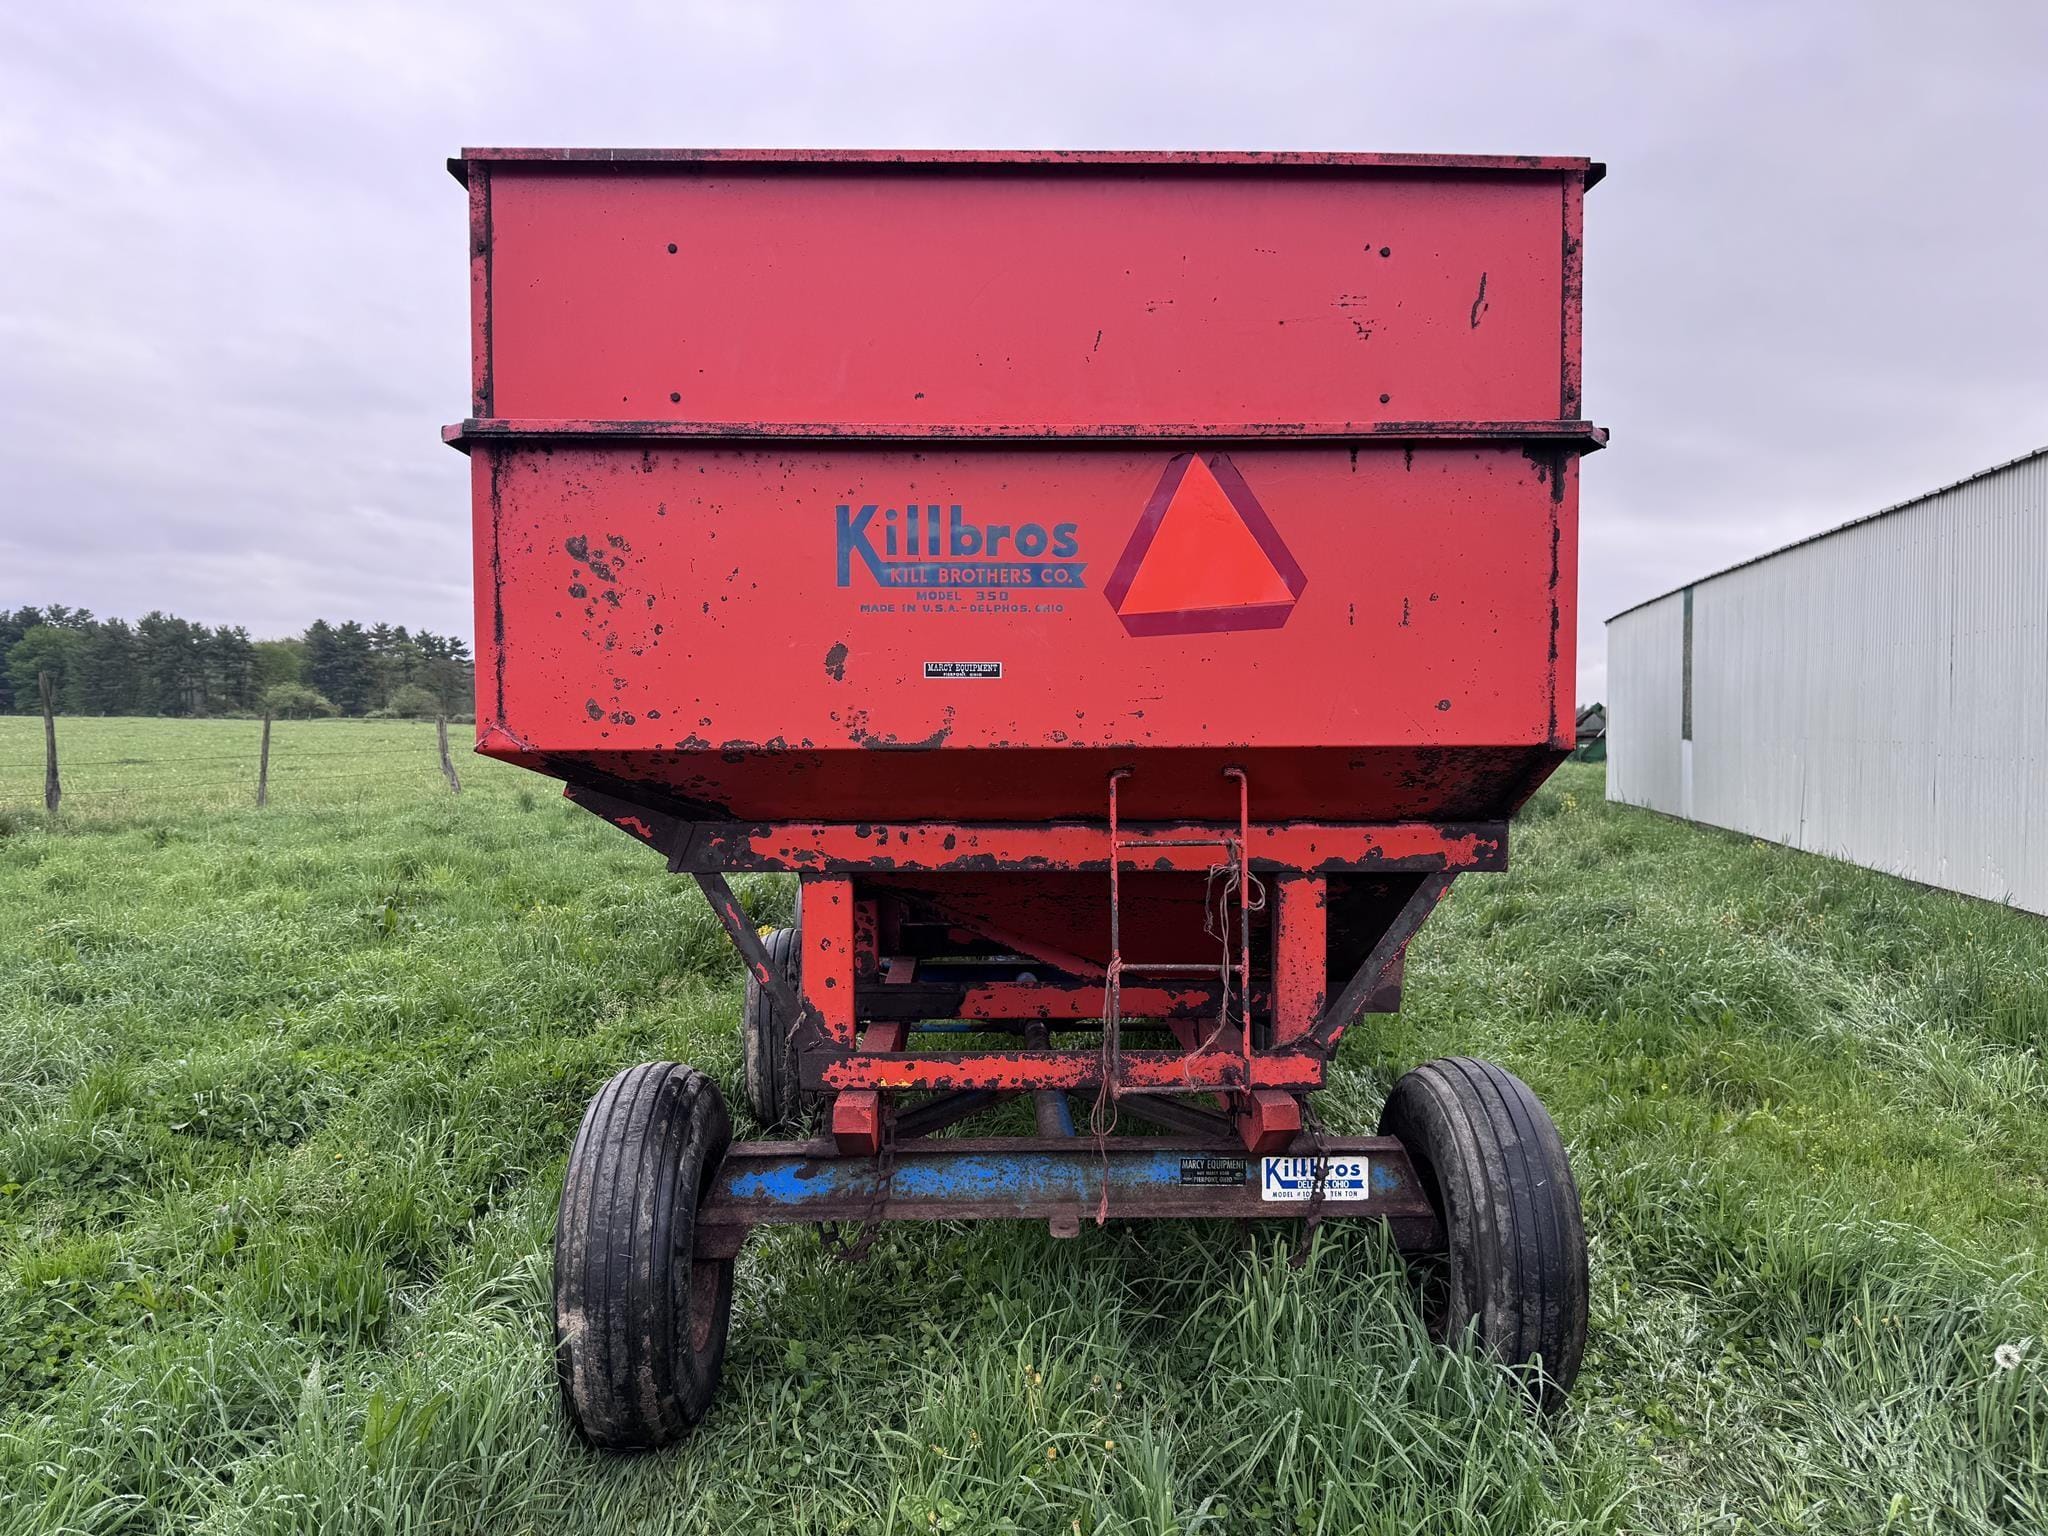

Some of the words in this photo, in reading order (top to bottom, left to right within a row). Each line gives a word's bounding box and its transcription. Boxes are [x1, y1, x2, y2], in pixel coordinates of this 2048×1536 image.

[835, 504, 1079, 588] Killbros
[890, 567, 928, 584] KILL
[938, 567, 1033, 584] BROTHERS
[1040, 567, 1073, 584] CO.
[916, 591, 962, 601] MODEL
[860, 603, 896, 613] MADE
[902, 603, 916, 613] IN
[1034, 603, 1064, 613] OHIO
[927, 663, 954, 672] MARCY
[955, 663, 998, 673] EQUIPMENT
[1182, 1159, 1205, 1169] MARCY
[1207, 1159, 1244, 1169] EQUIPMENT
[1265, 1158, 1361, 1190] Killbos
